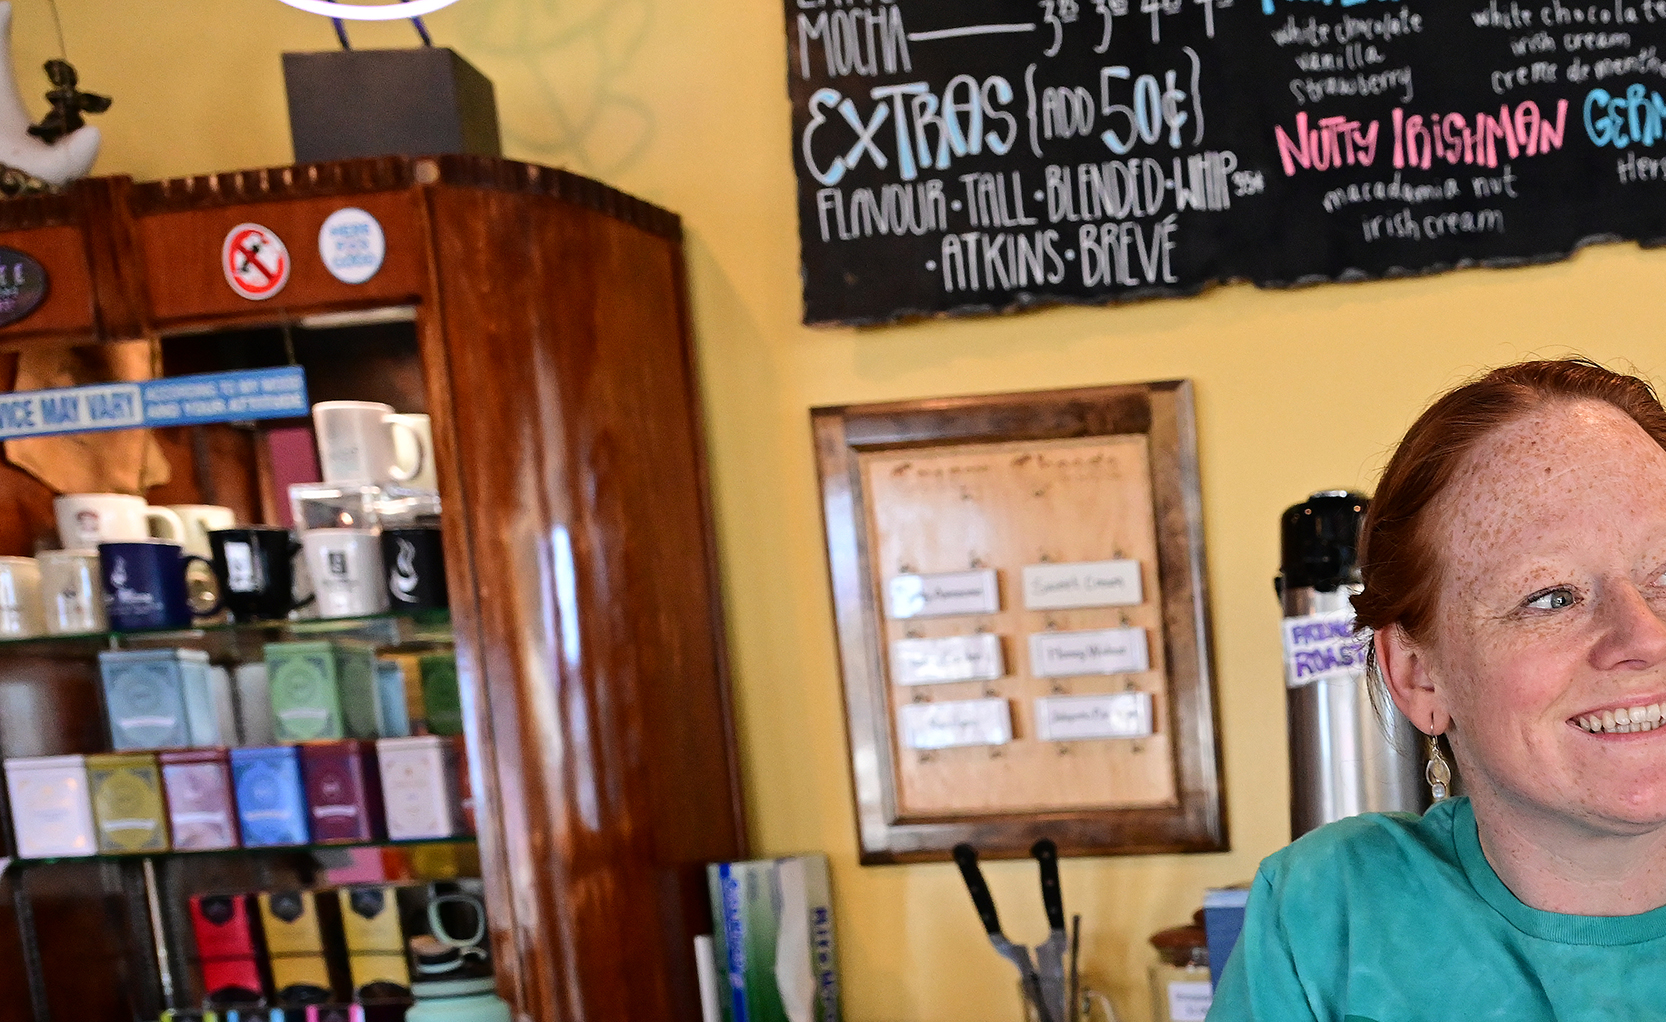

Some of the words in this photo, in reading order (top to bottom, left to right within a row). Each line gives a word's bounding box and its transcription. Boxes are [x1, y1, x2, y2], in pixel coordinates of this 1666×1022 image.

[797, 4, 912, 80] MOCHA
[1471, 0, 1533, 30] white
[1294, 40, 1386, 72] vanilla
[803, 74, 1017, 186] EXTRAS
[816, 180, 948, 242] FLAVOUR
[959, 171, 1039, 228] TALL
[1044, 156, 1166, 223] BLENDED
[1470, 163, 1519, 199] nut
[942, 229, 1066, 292] ATKINS
